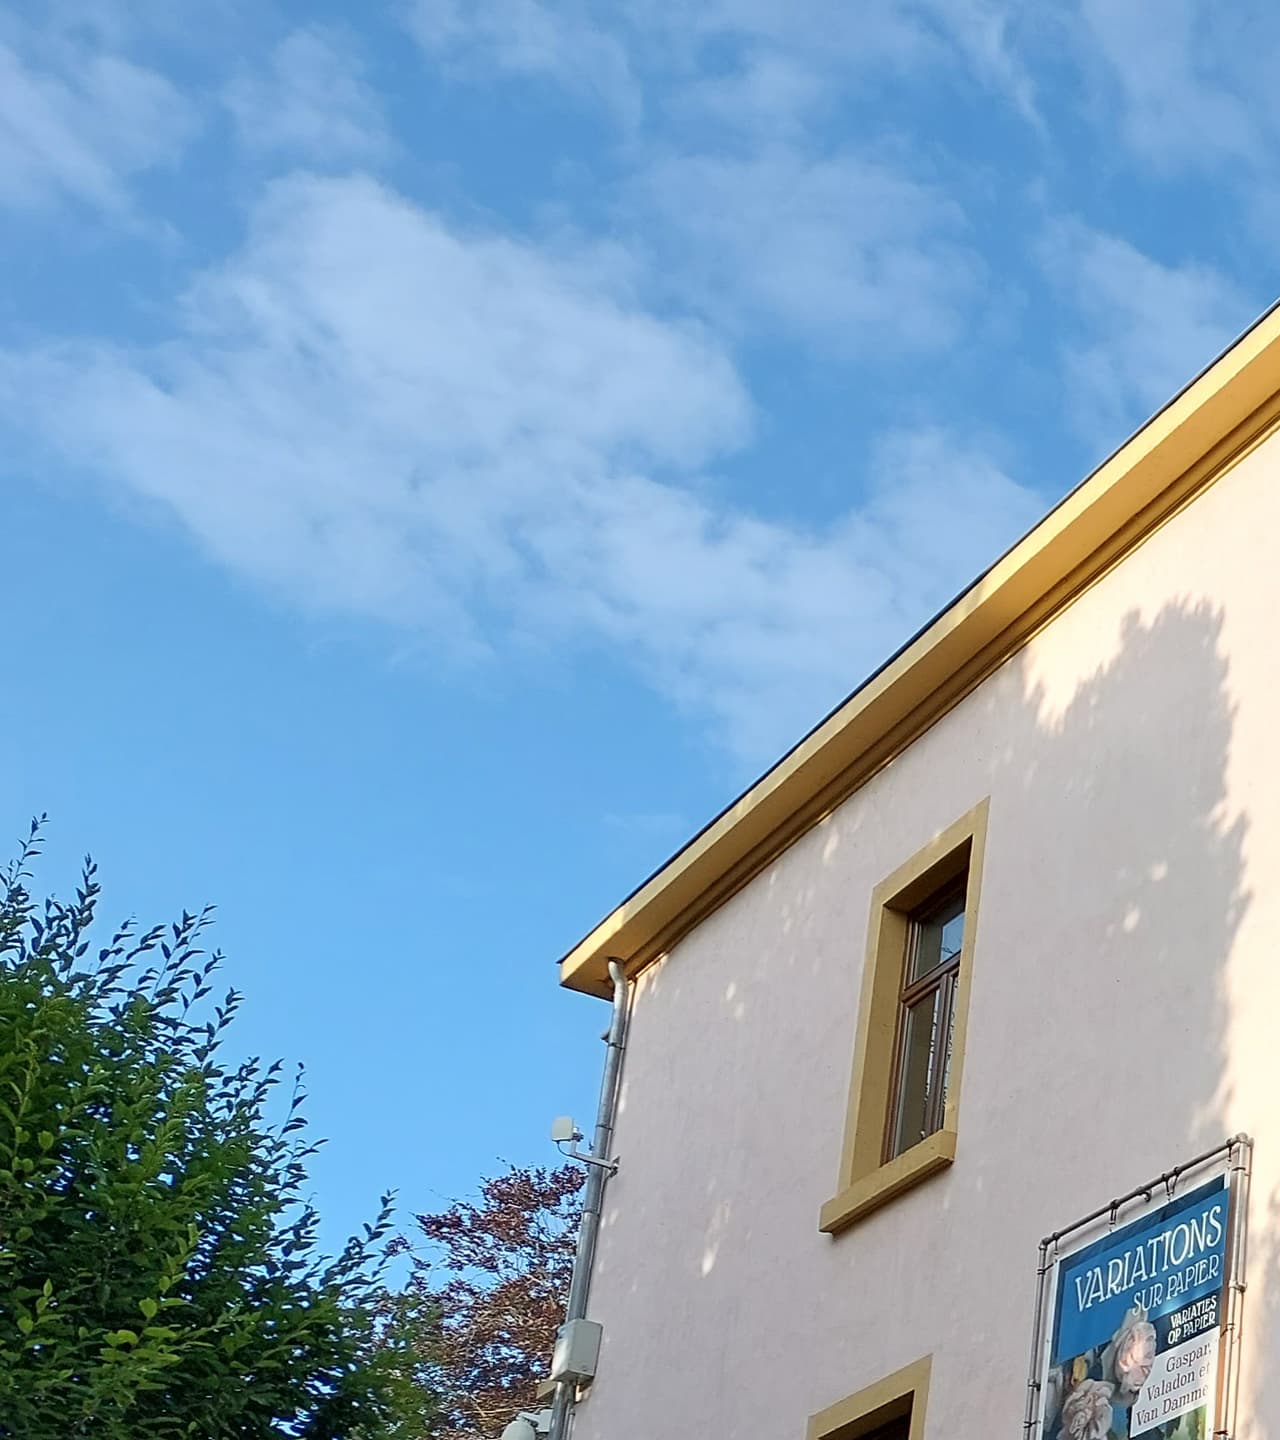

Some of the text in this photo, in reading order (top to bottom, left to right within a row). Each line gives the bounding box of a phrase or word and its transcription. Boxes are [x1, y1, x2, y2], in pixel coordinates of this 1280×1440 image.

[1074, 1205, 1222, 1312] VARIATIONS
[1132, 1254, 1219, 1316] SUR PAPIER
[1167, 1311, 1216, 1345] OP PAPIER
[1170, 1295, 1217, 1329] VARIATIES
[1147, 1370, 1195, 1401] Valadon
[1136, 1384, 1208, 1426] Van Damme
